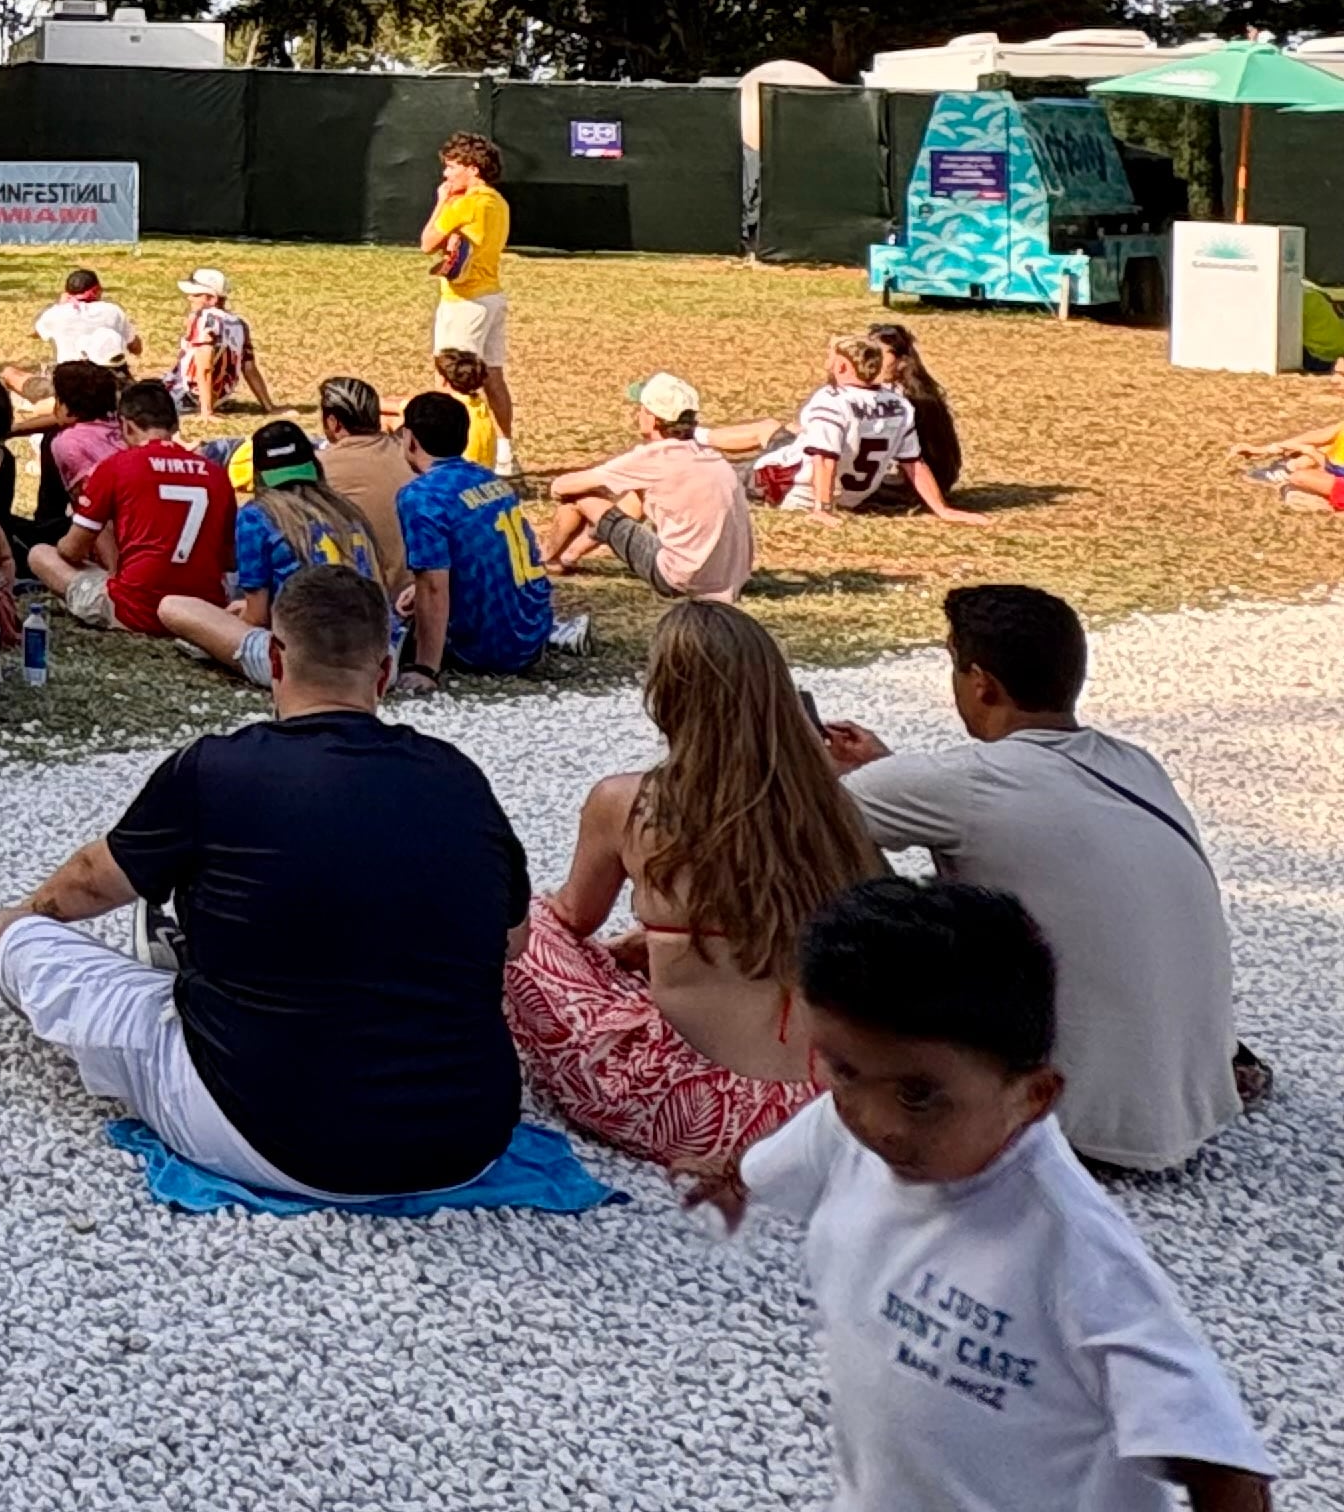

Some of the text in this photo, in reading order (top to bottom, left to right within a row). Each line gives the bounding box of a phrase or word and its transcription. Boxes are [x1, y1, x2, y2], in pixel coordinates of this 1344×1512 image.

[148, 456, 210, 476] WIRTZ
[840, 438, 889, 491] 5
[158, 484, 210, 564] 7
[914, 1272, 1014, 1337] I JUST
